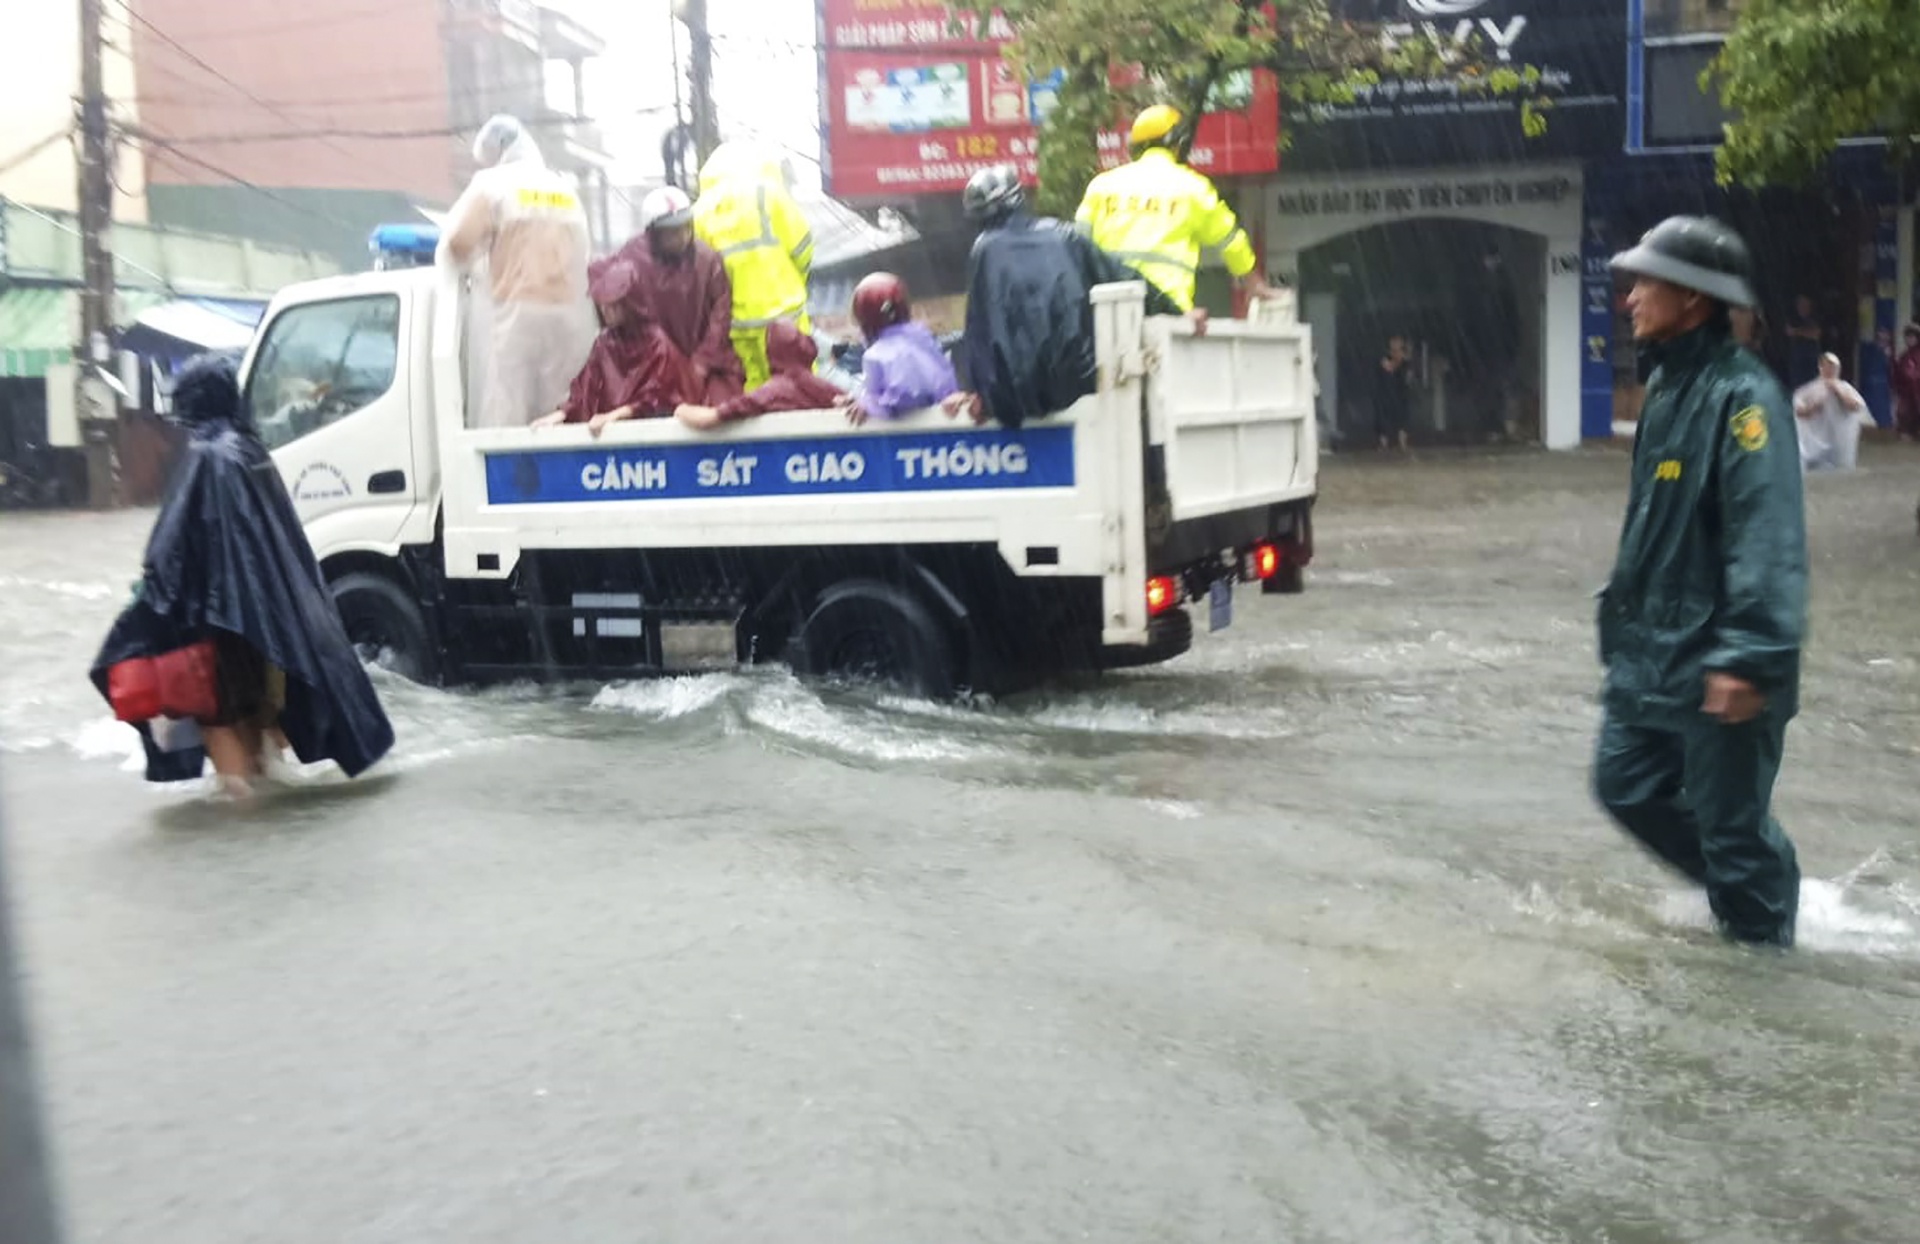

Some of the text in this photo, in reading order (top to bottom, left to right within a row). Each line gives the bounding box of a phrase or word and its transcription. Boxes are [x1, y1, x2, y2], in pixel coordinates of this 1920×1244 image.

[580, 440, 1028, 491] CẢNH SÁT GIAO THÔNG
